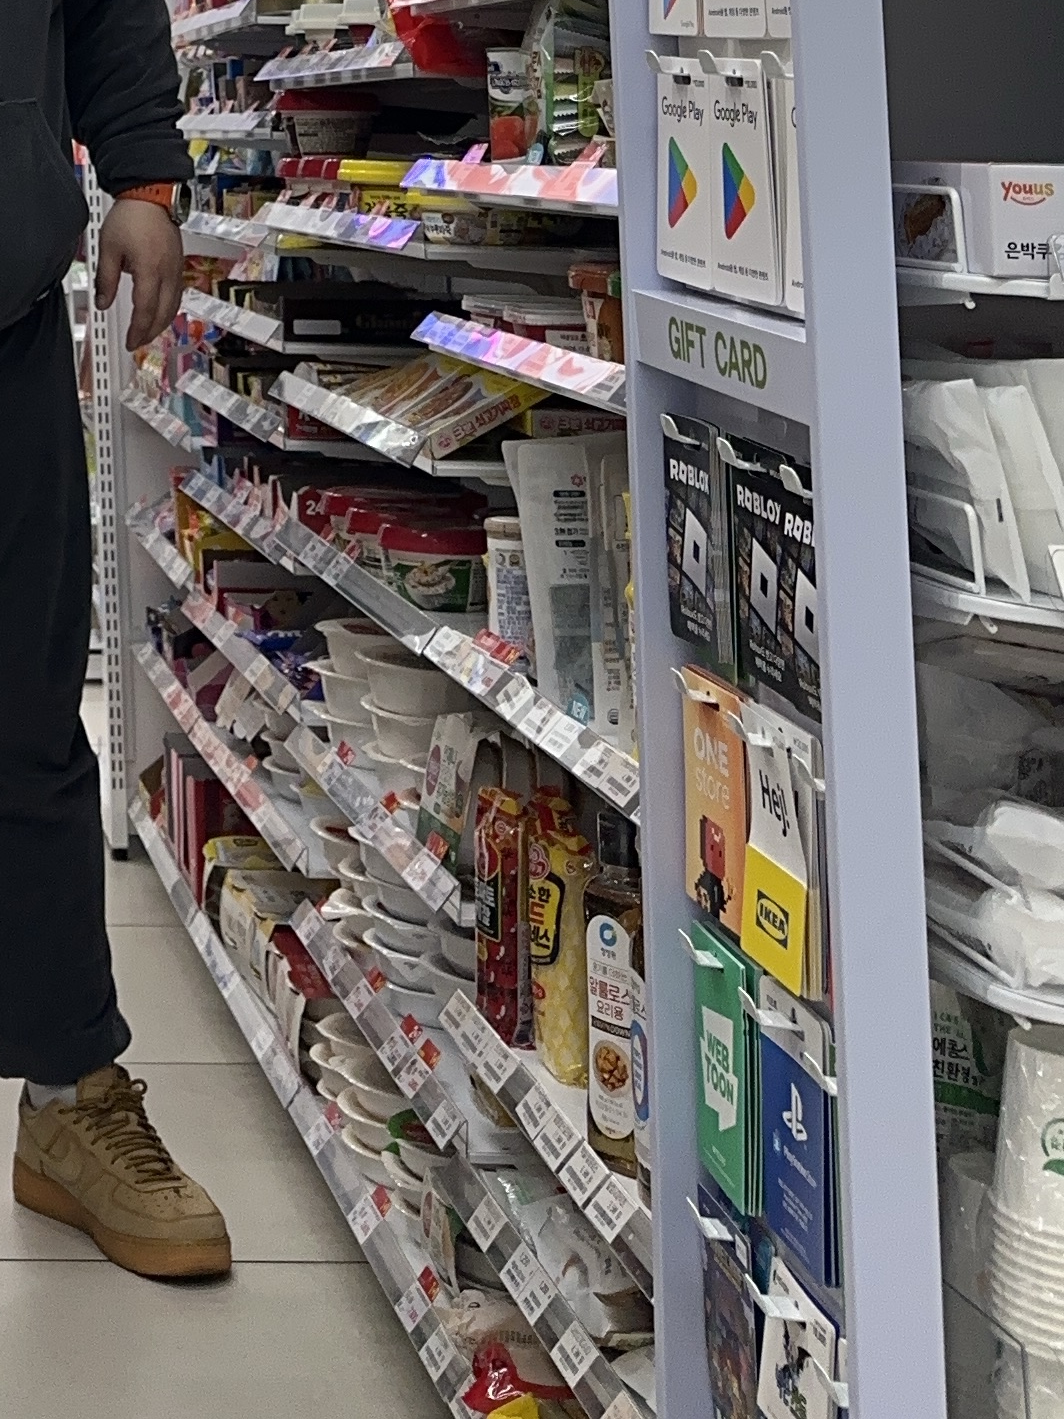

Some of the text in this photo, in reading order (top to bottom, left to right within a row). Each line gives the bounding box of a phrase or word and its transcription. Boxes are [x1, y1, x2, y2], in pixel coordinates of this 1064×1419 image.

[661, 96, 704, 127] Google Play
[713, 99, 758, 130] Google Play
[1000, 181, 1055, 202] youus
[1004, 241, 1053, 260] 은박쿠
[668, 316, 768, 390] GIFT CARD
[669, 457, 711, 495] ROBLOX
[784, 511, 813, 543] ROB
[692, 726, 730, 778] ONE
[694, 765, 731, 810] store
[758, 768, 791, 838] Hej!
[758, 901, 787, 936] IKEA
[596, 998, 625, 1021] 요리용
[705, 1029, 731, 1074] WEB
[704, 1052, 735, 1106] TOON
